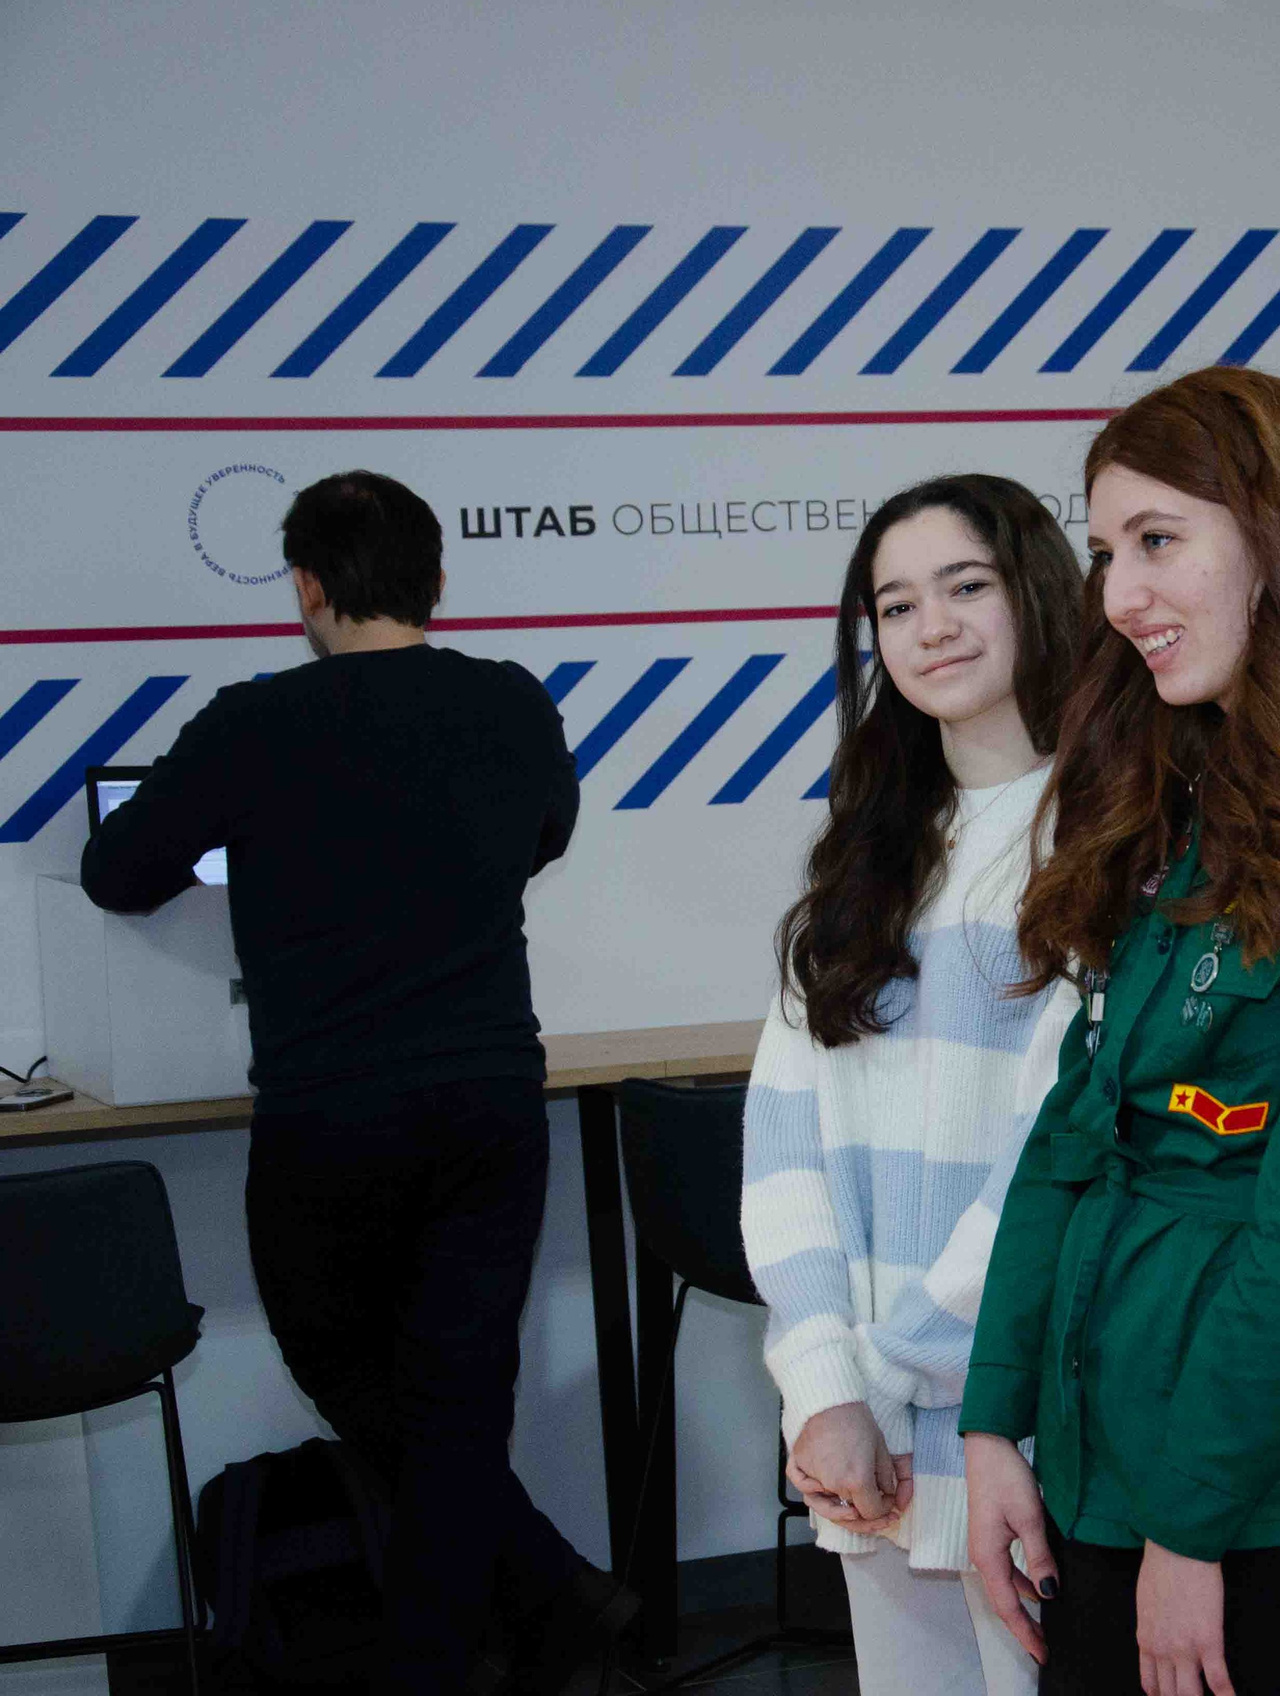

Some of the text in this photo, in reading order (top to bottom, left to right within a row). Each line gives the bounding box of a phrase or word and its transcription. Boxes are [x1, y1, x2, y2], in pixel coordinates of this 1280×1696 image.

[187, 484, 208, 541] БУДУЩЕЕ
[205, 464, 285, 486] УВЕРЕННОСТЬ
[460, 504, 597, 539] ШТАБ
